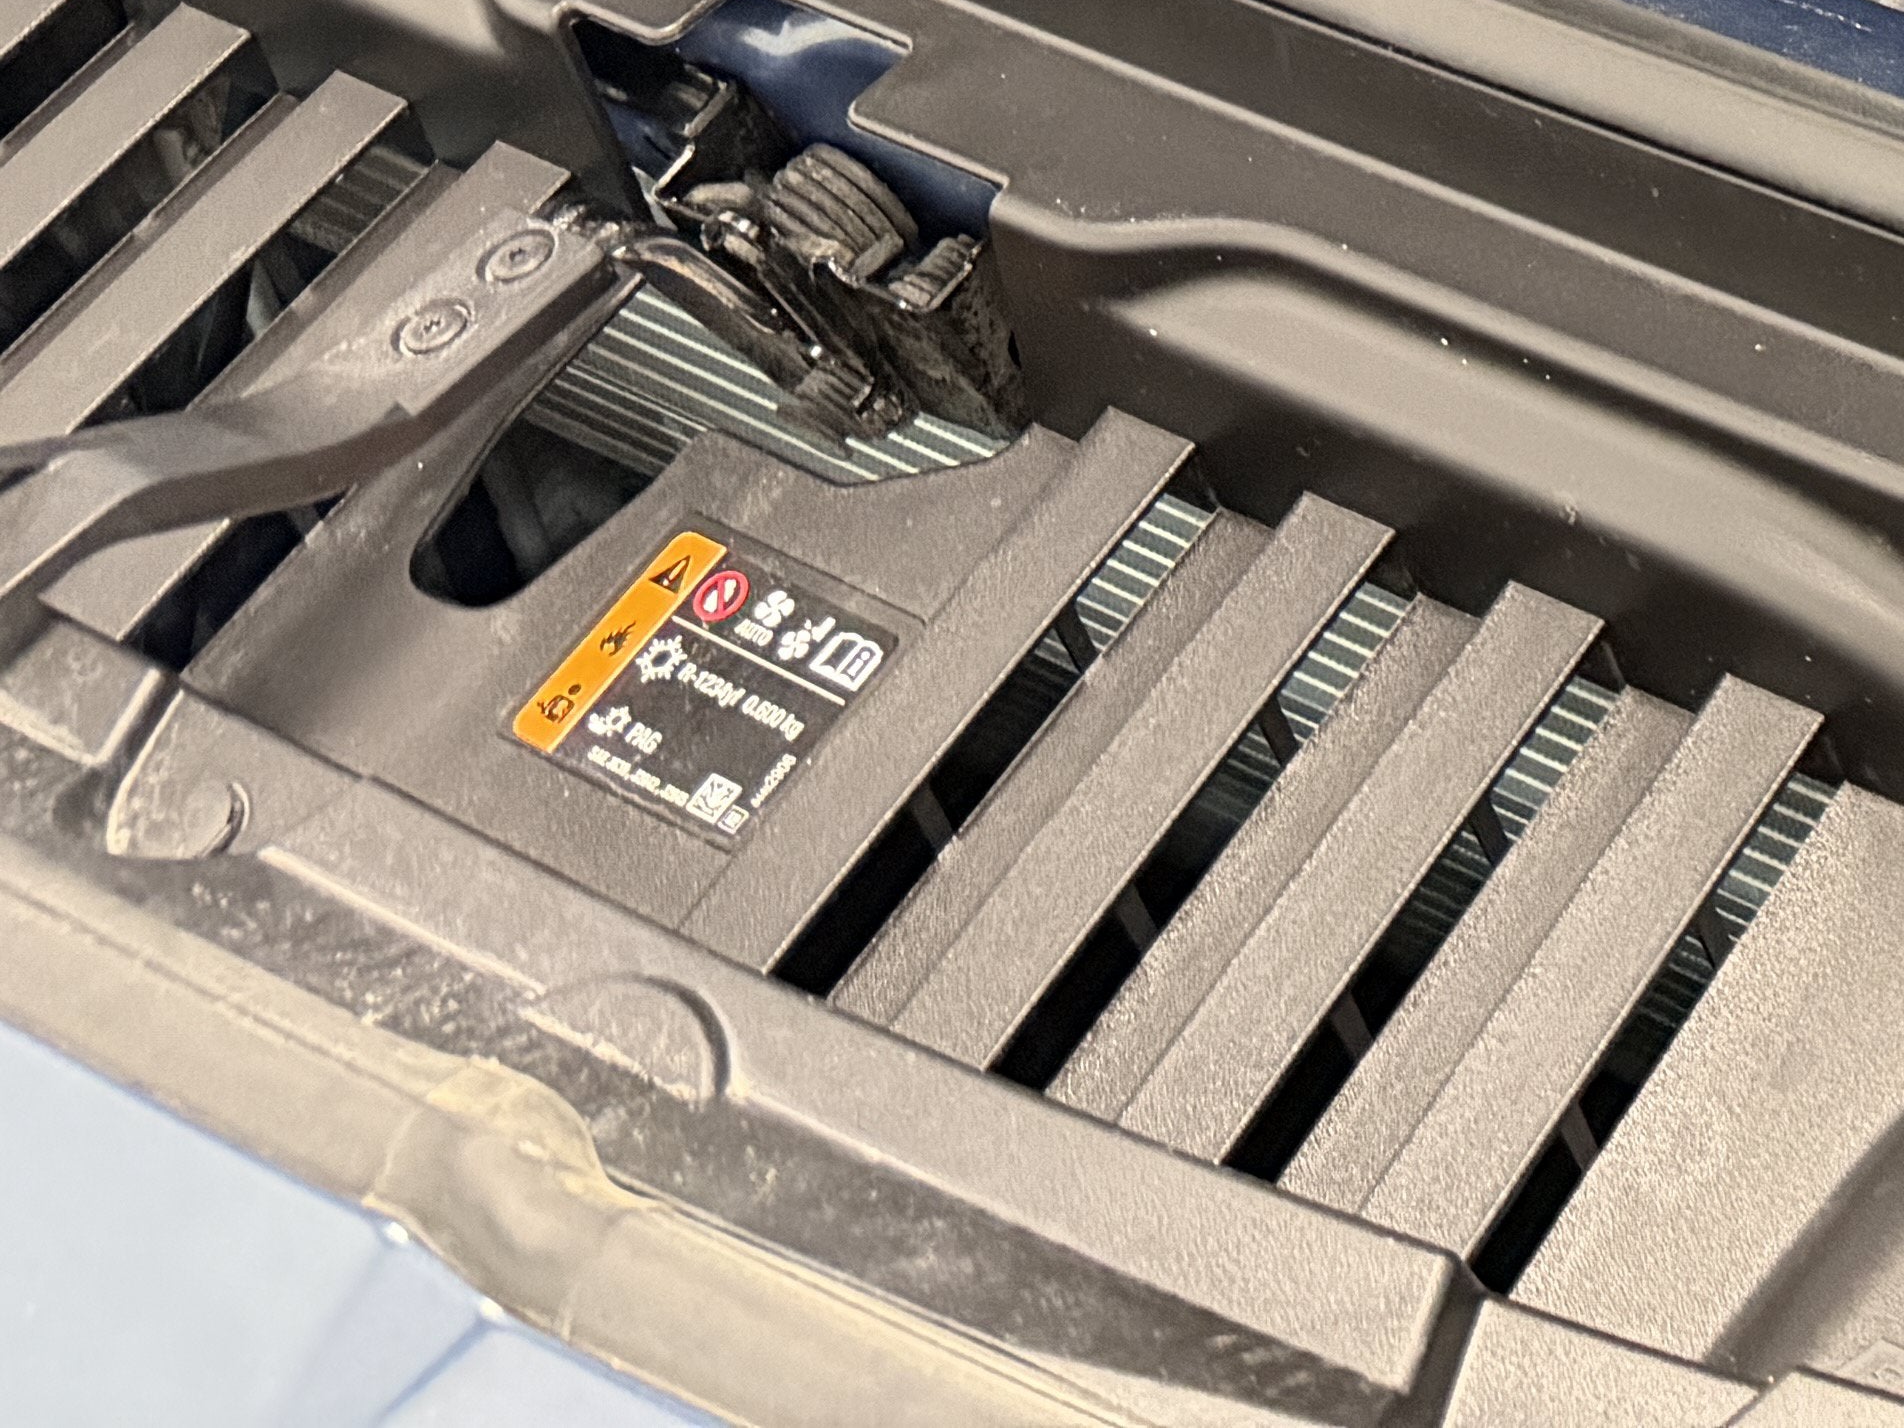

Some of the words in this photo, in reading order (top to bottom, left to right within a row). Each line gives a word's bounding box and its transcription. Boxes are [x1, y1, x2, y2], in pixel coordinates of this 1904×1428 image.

[734, 619, 774, 647] AUTO
[742, 695, 787, 728] 0.600
[780, 713, 805, 742] kg
[625, 722, 663, 755] PAG
